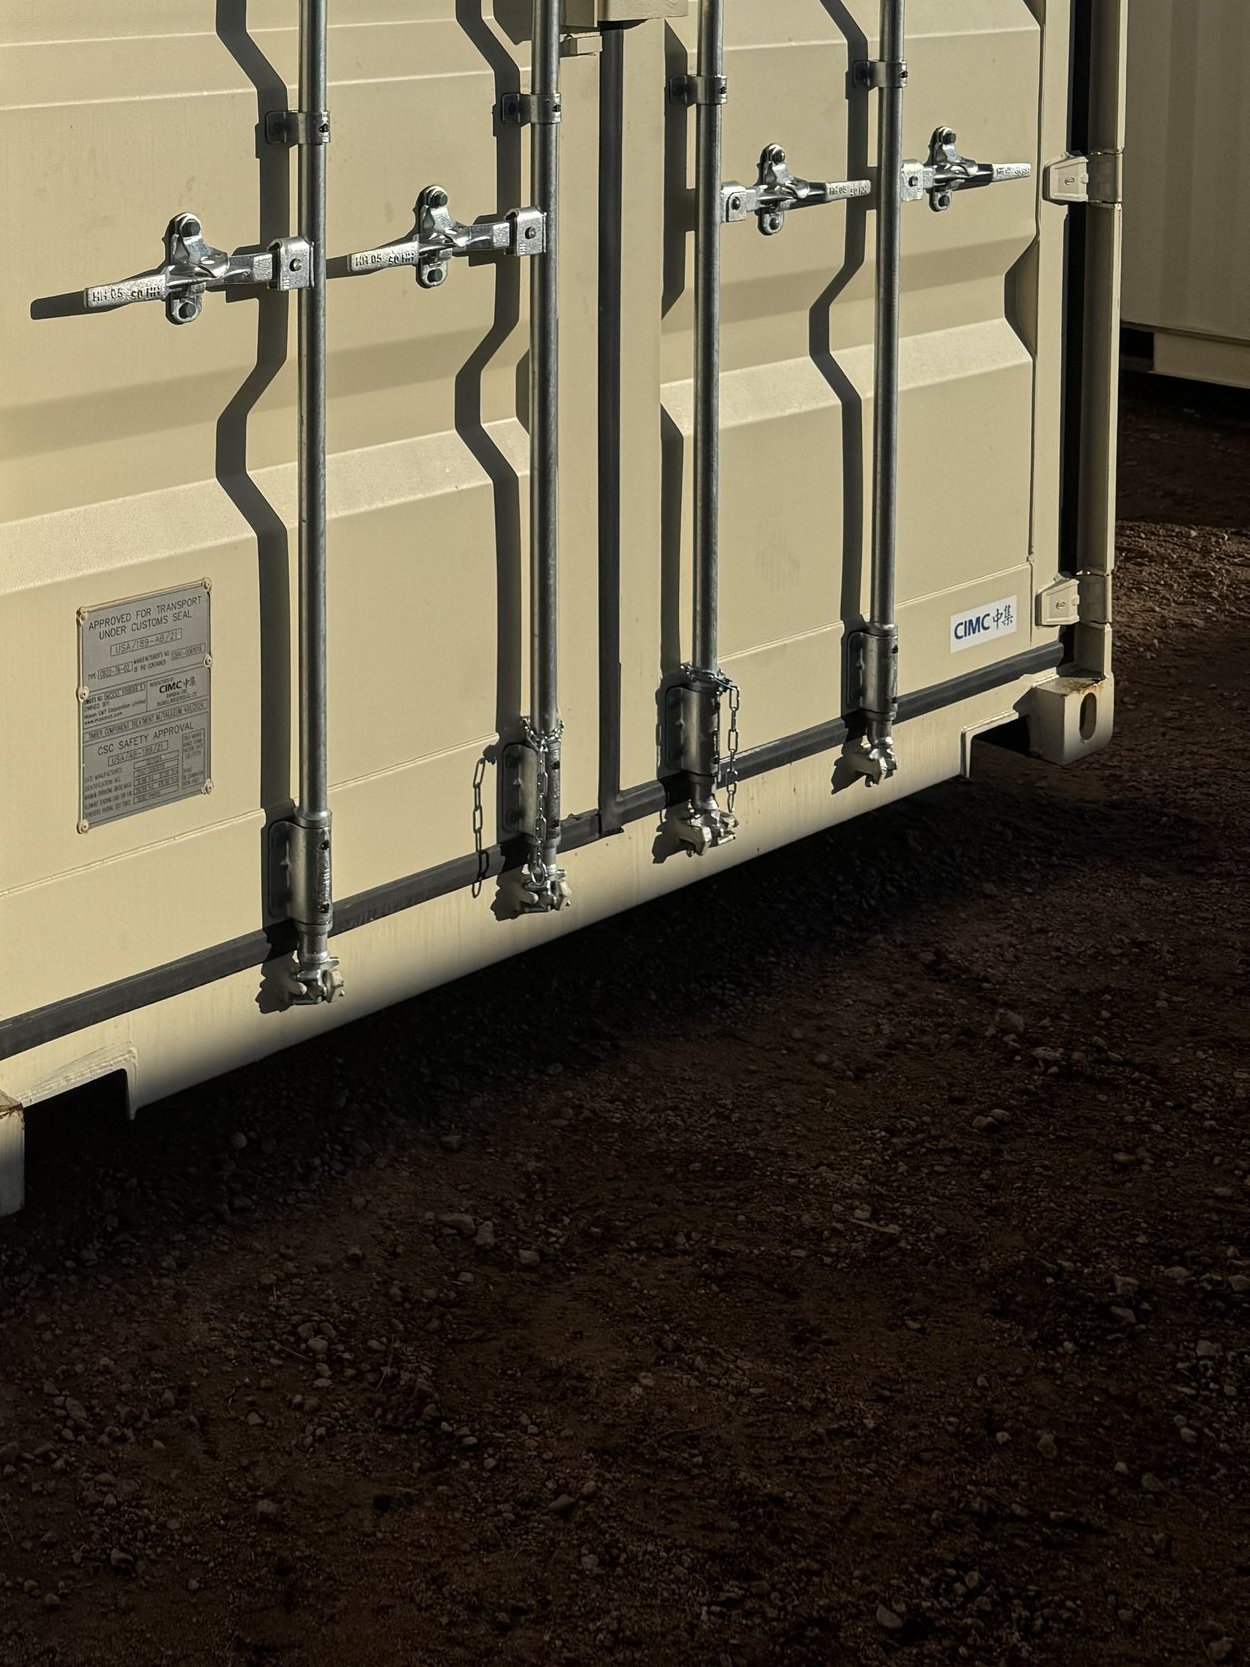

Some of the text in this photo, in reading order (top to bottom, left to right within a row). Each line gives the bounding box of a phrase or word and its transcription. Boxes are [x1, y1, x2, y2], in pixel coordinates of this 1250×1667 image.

[88, 595, 202, 631] APPROVED FOR TRANSPORT
[98, 610, 192, 640] UNDER CUSTOMS SEAL
[954, 613, 991, 640] CIMC
[159, 680, 183, 694] CIMC
[97, 721, 194, 756] CSC SAFETY APPROVAL
